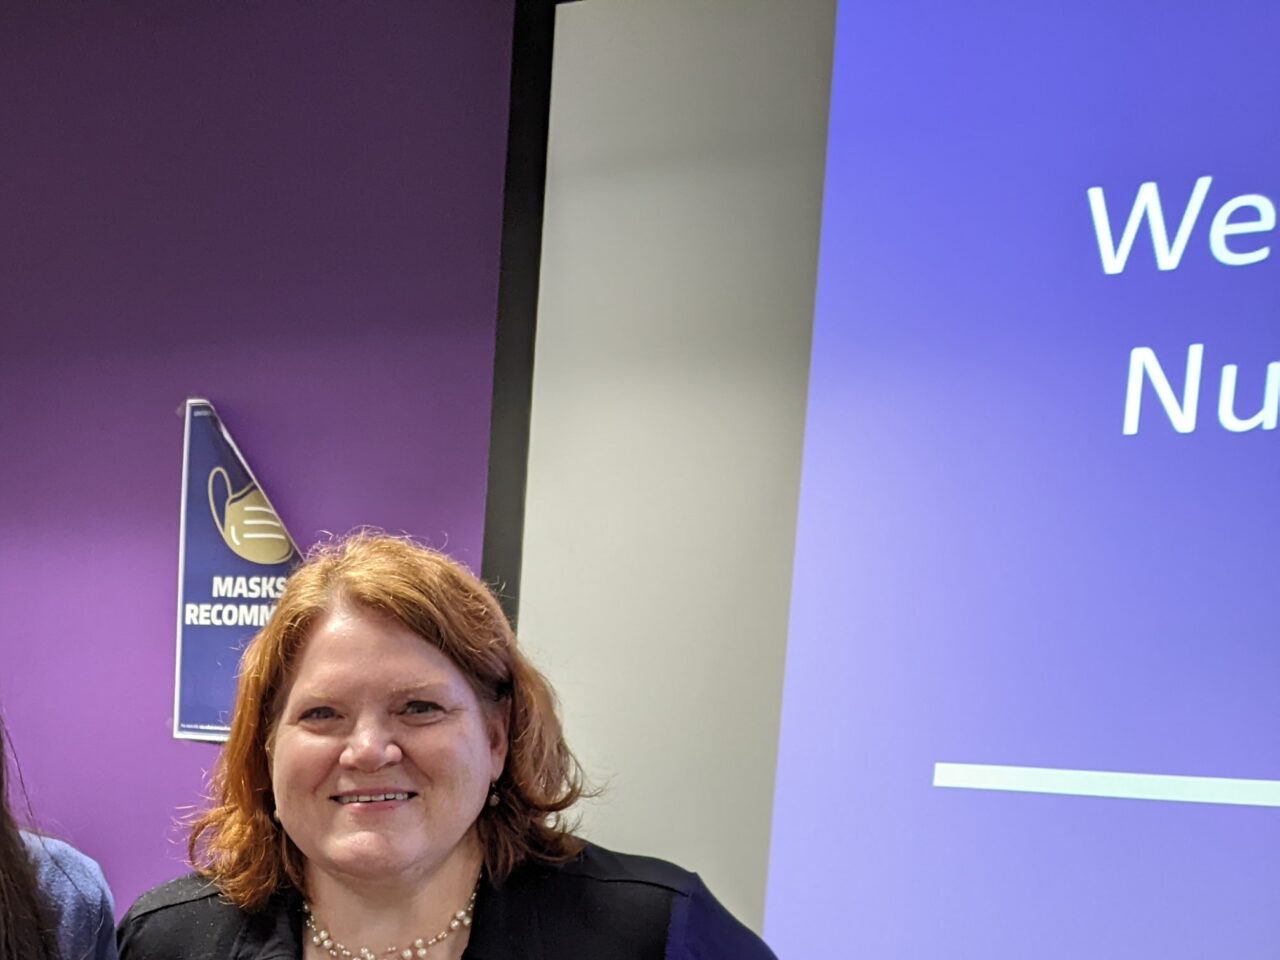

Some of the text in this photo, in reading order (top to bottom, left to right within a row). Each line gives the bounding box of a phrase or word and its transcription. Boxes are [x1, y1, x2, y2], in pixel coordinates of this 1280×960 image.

[1087, 176, 1277, 275] We
[1122, 344, 1280, 435] Nu
[212, 576, 288, 599] MASKS
